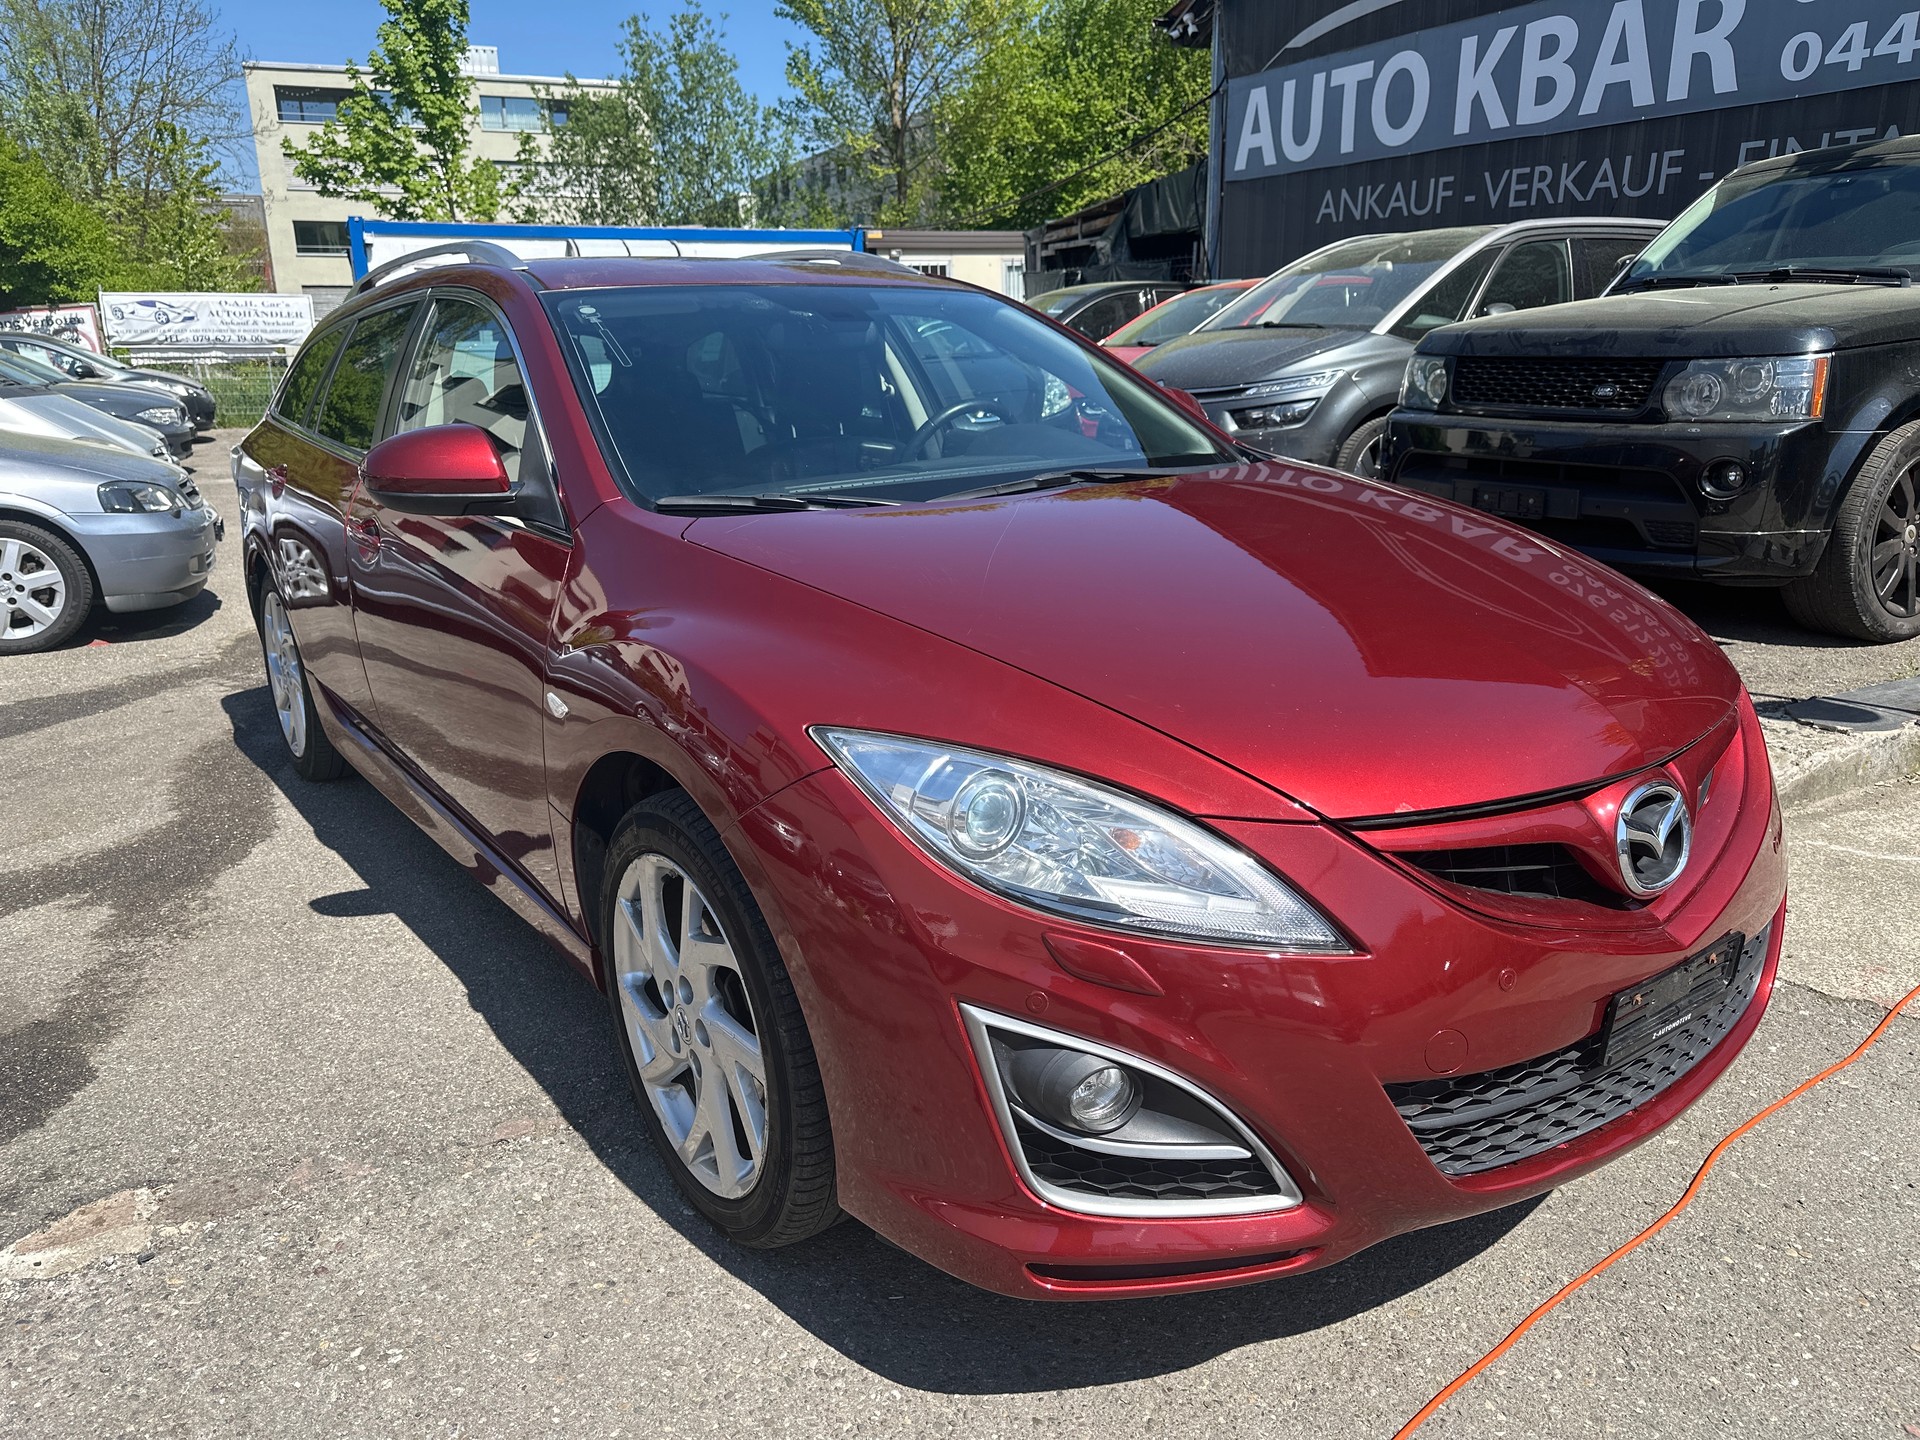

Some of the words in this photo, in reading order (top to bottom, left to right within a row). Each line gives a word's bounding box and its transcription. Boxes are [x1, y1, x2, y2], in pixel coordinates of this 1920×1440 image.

[1780, 11, 1920, 81] 044
[1234, 49, 1430, 171] AUTO
[1453, 0, 1747, 135] KBAR
[1316, 176, 1454, 223] ANKAUF
[1483, 149, 1685, 209] VERKAUF
[192, 335, 211, 343] 079
[215, 334, 232, 343] 627
